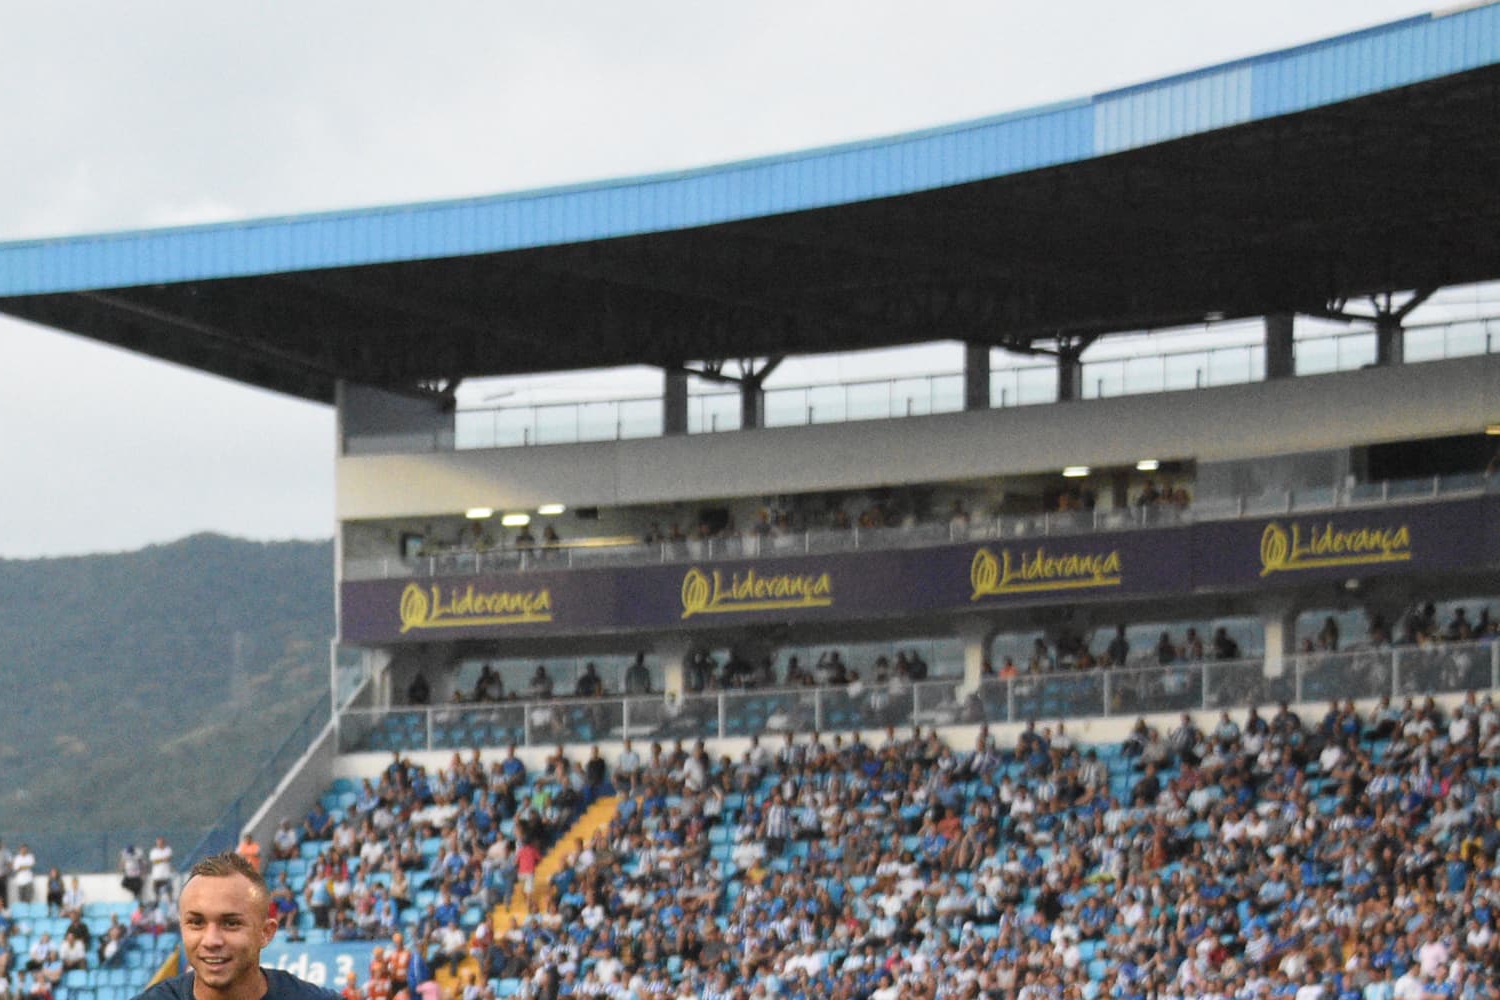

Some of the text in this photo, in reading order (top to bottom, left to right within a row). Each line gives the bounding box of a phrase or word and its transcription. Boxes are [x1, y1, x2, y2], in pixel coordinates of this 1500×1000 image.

[1290, 521, 1411, 561] Liderança
[709, 567, 831, 607] Liderança
[1001, 547, 1121, 587] Liderança
[429, 582, 551, 622] Liderança
